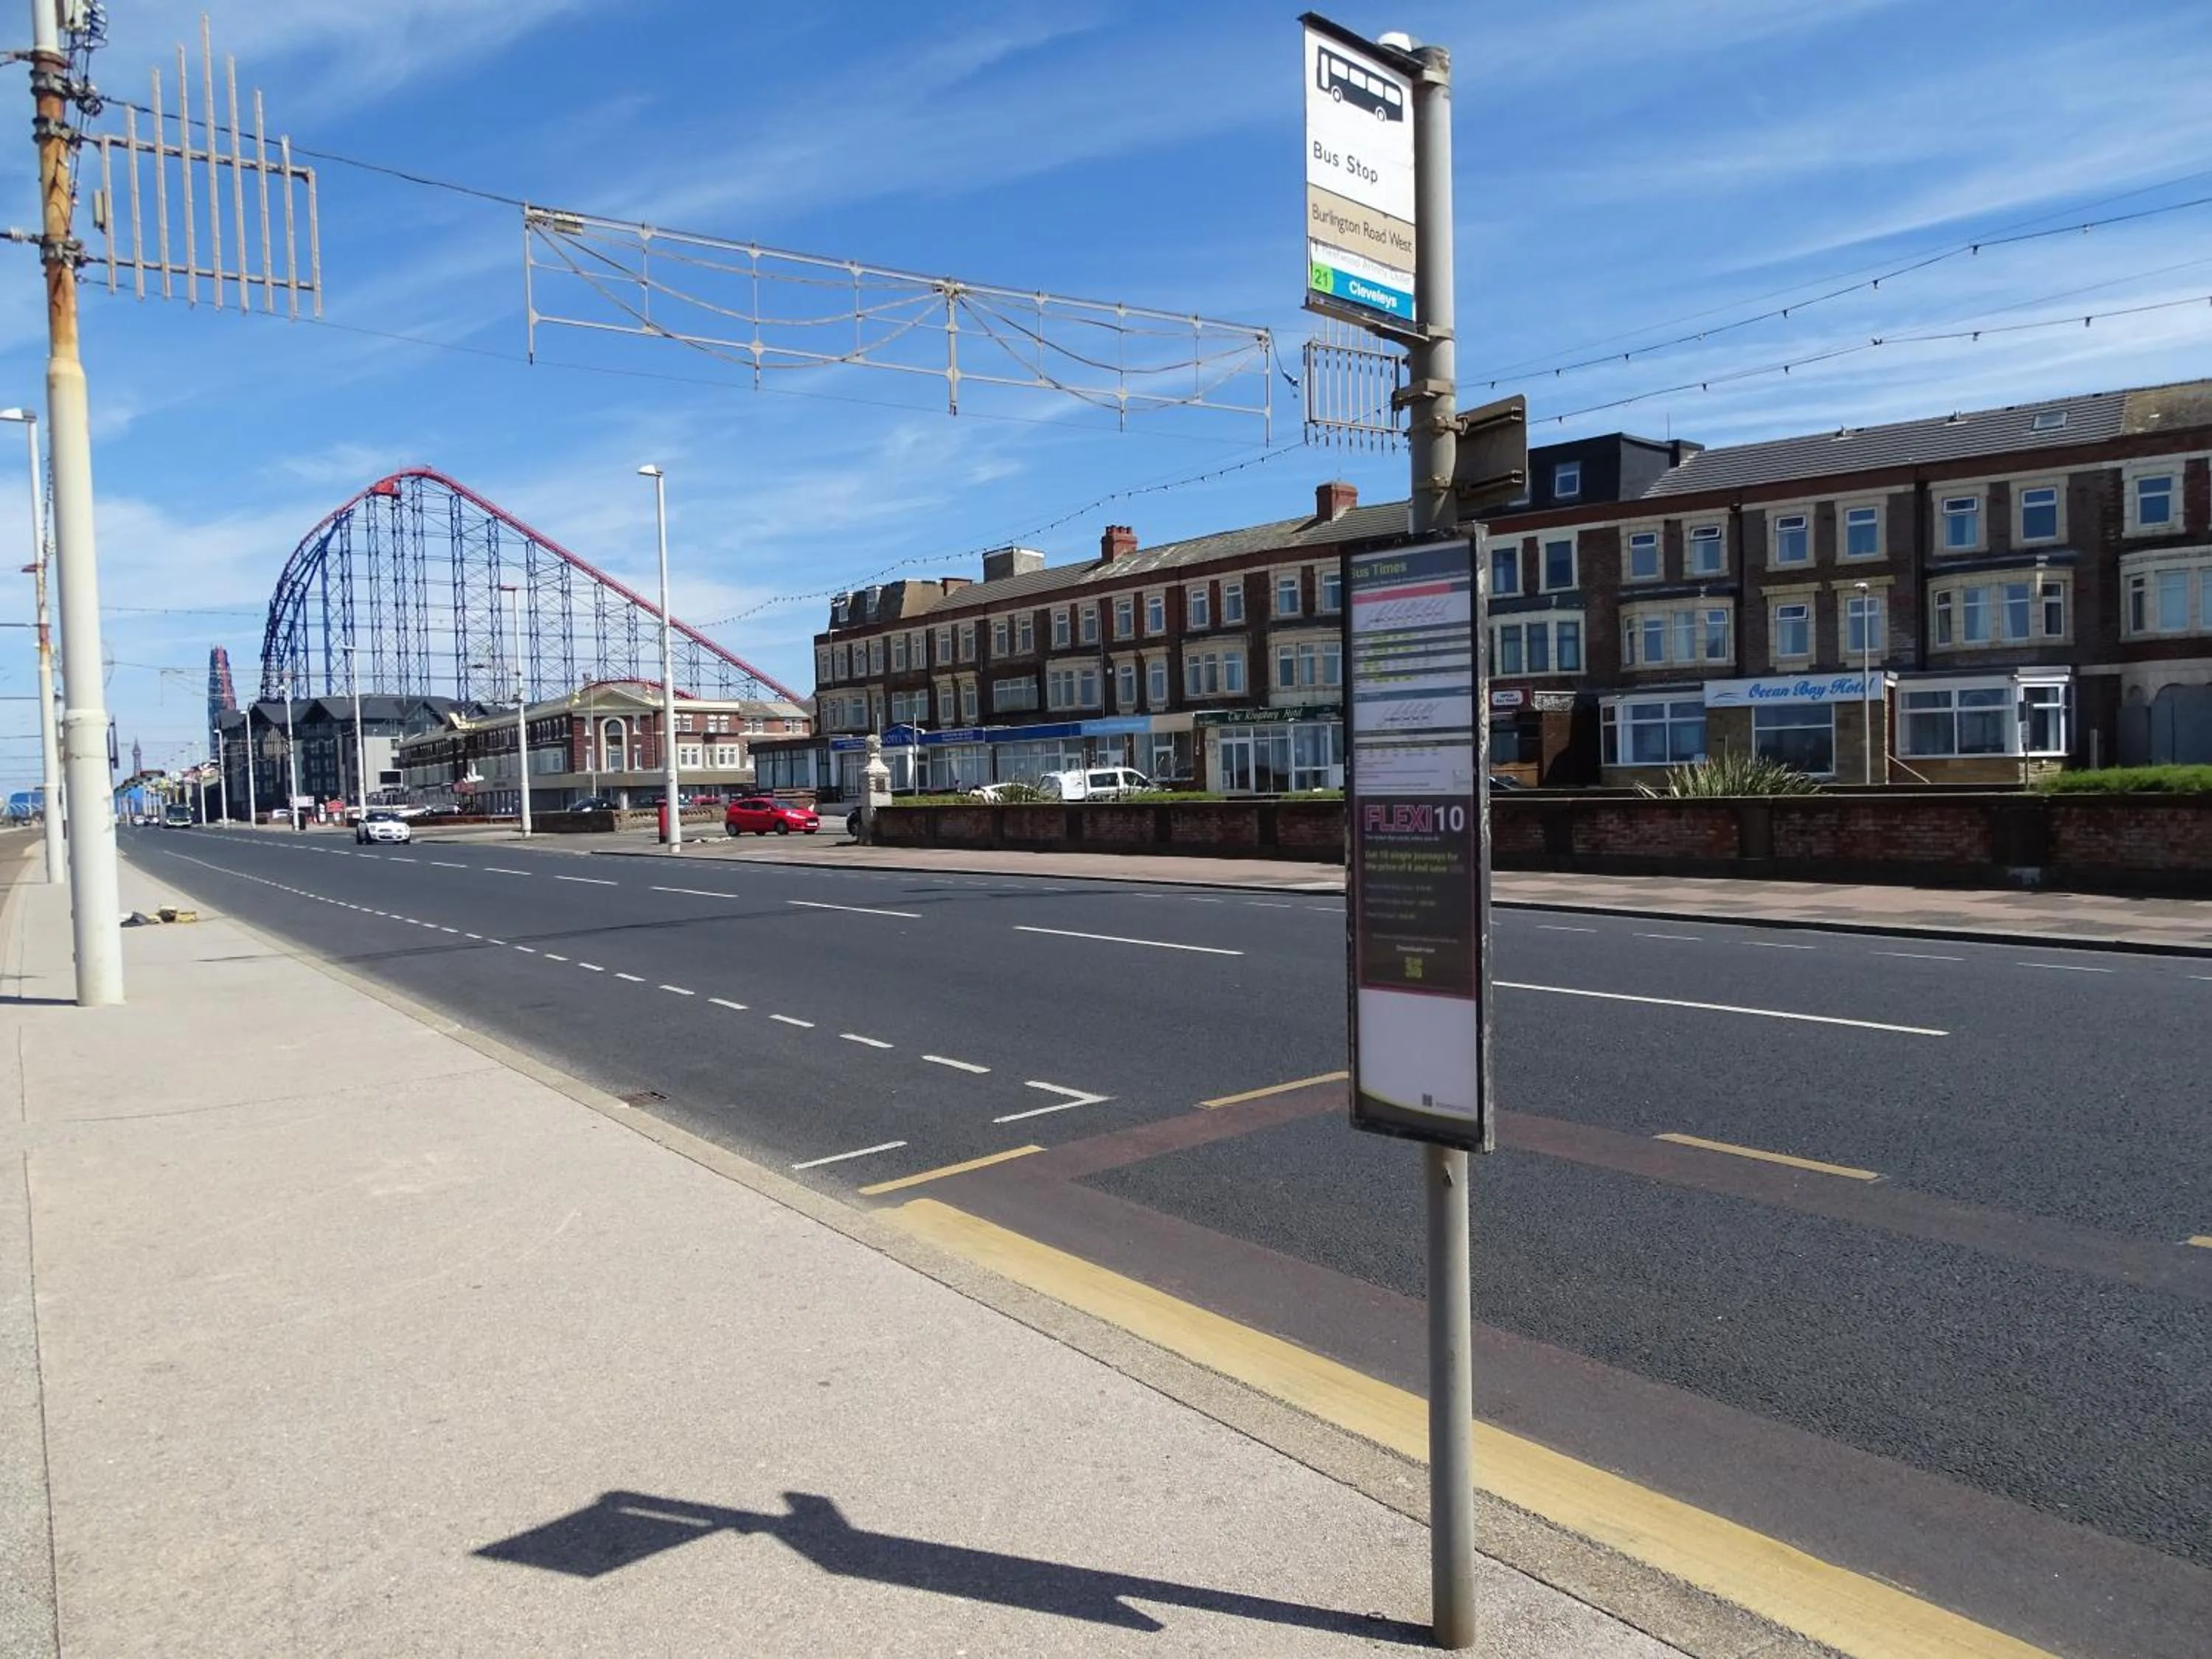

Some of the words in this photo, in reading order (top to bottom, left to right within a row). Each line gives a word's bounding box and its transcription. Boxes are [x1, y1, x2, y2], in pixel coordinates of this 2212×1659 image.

[1313, 141, 1339, 167] Bus
[1346, 155, 1378, 184] Stop
[1312, 203, 1360, 236] Burlington
[1363, 221, 1387, 244] Road
[1388, 230, 1412, 253] West
[1315, 268, 1328, 287] 21
[1349, 280, 1397, 309] Cleveleys
[1372, 562, 1408, 576] Times
[1749, 684, 1790, 698] Ocean
[1792, 681, 1826, 700] Bay
